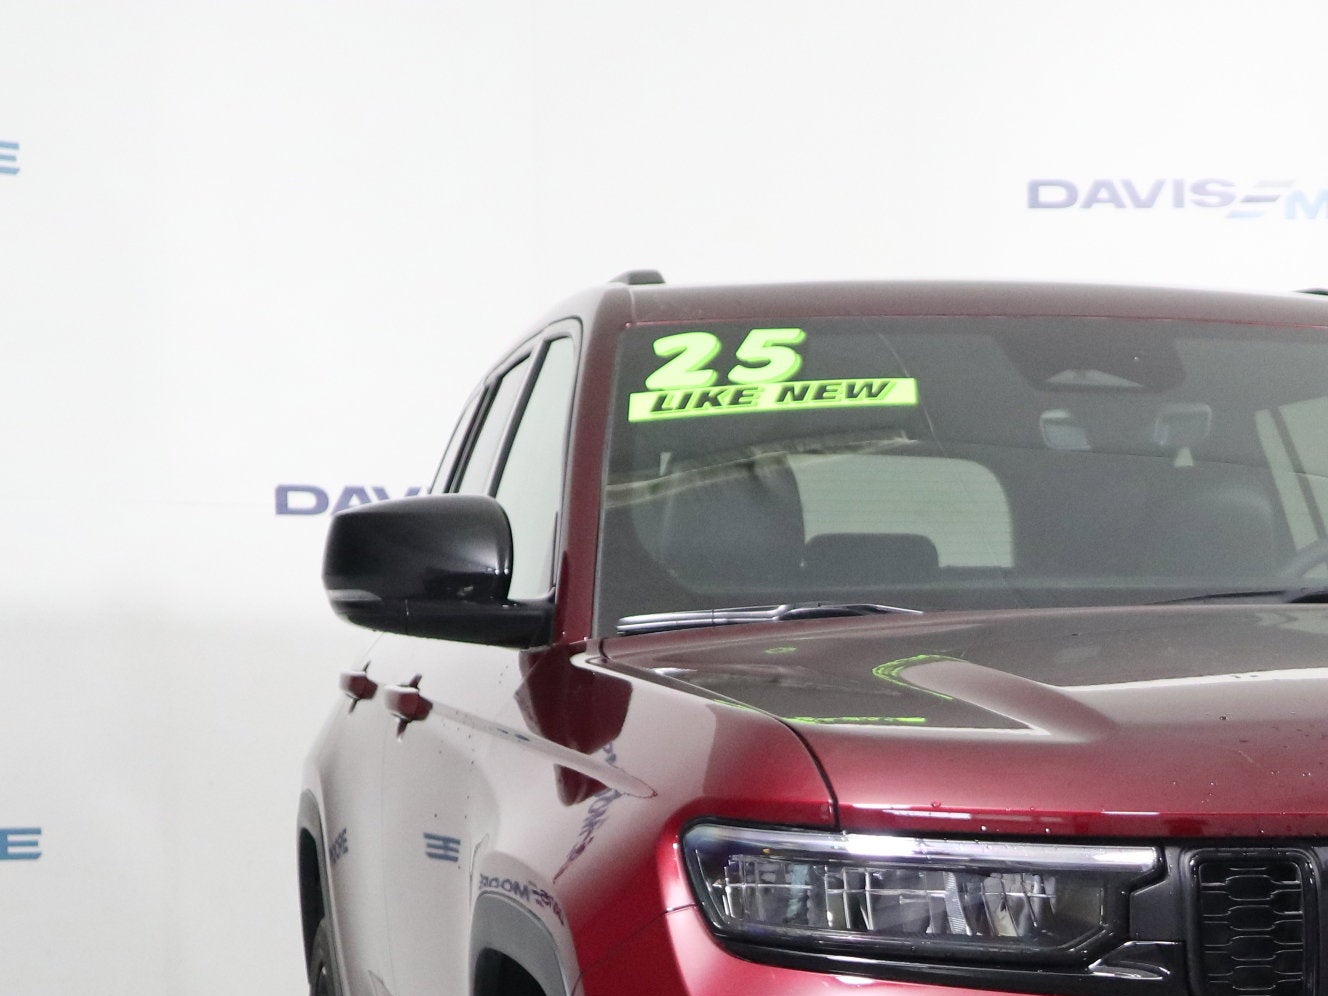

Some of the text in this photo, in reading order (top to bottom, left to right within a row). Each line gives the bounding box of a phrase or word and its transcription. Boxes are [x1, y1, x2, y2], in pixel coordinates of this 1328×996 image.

[1026, 178, 1237, 209] DAVIS
[645, 328, 807, 391] 25
[650, 380, 891, 413] LIKE NEW
